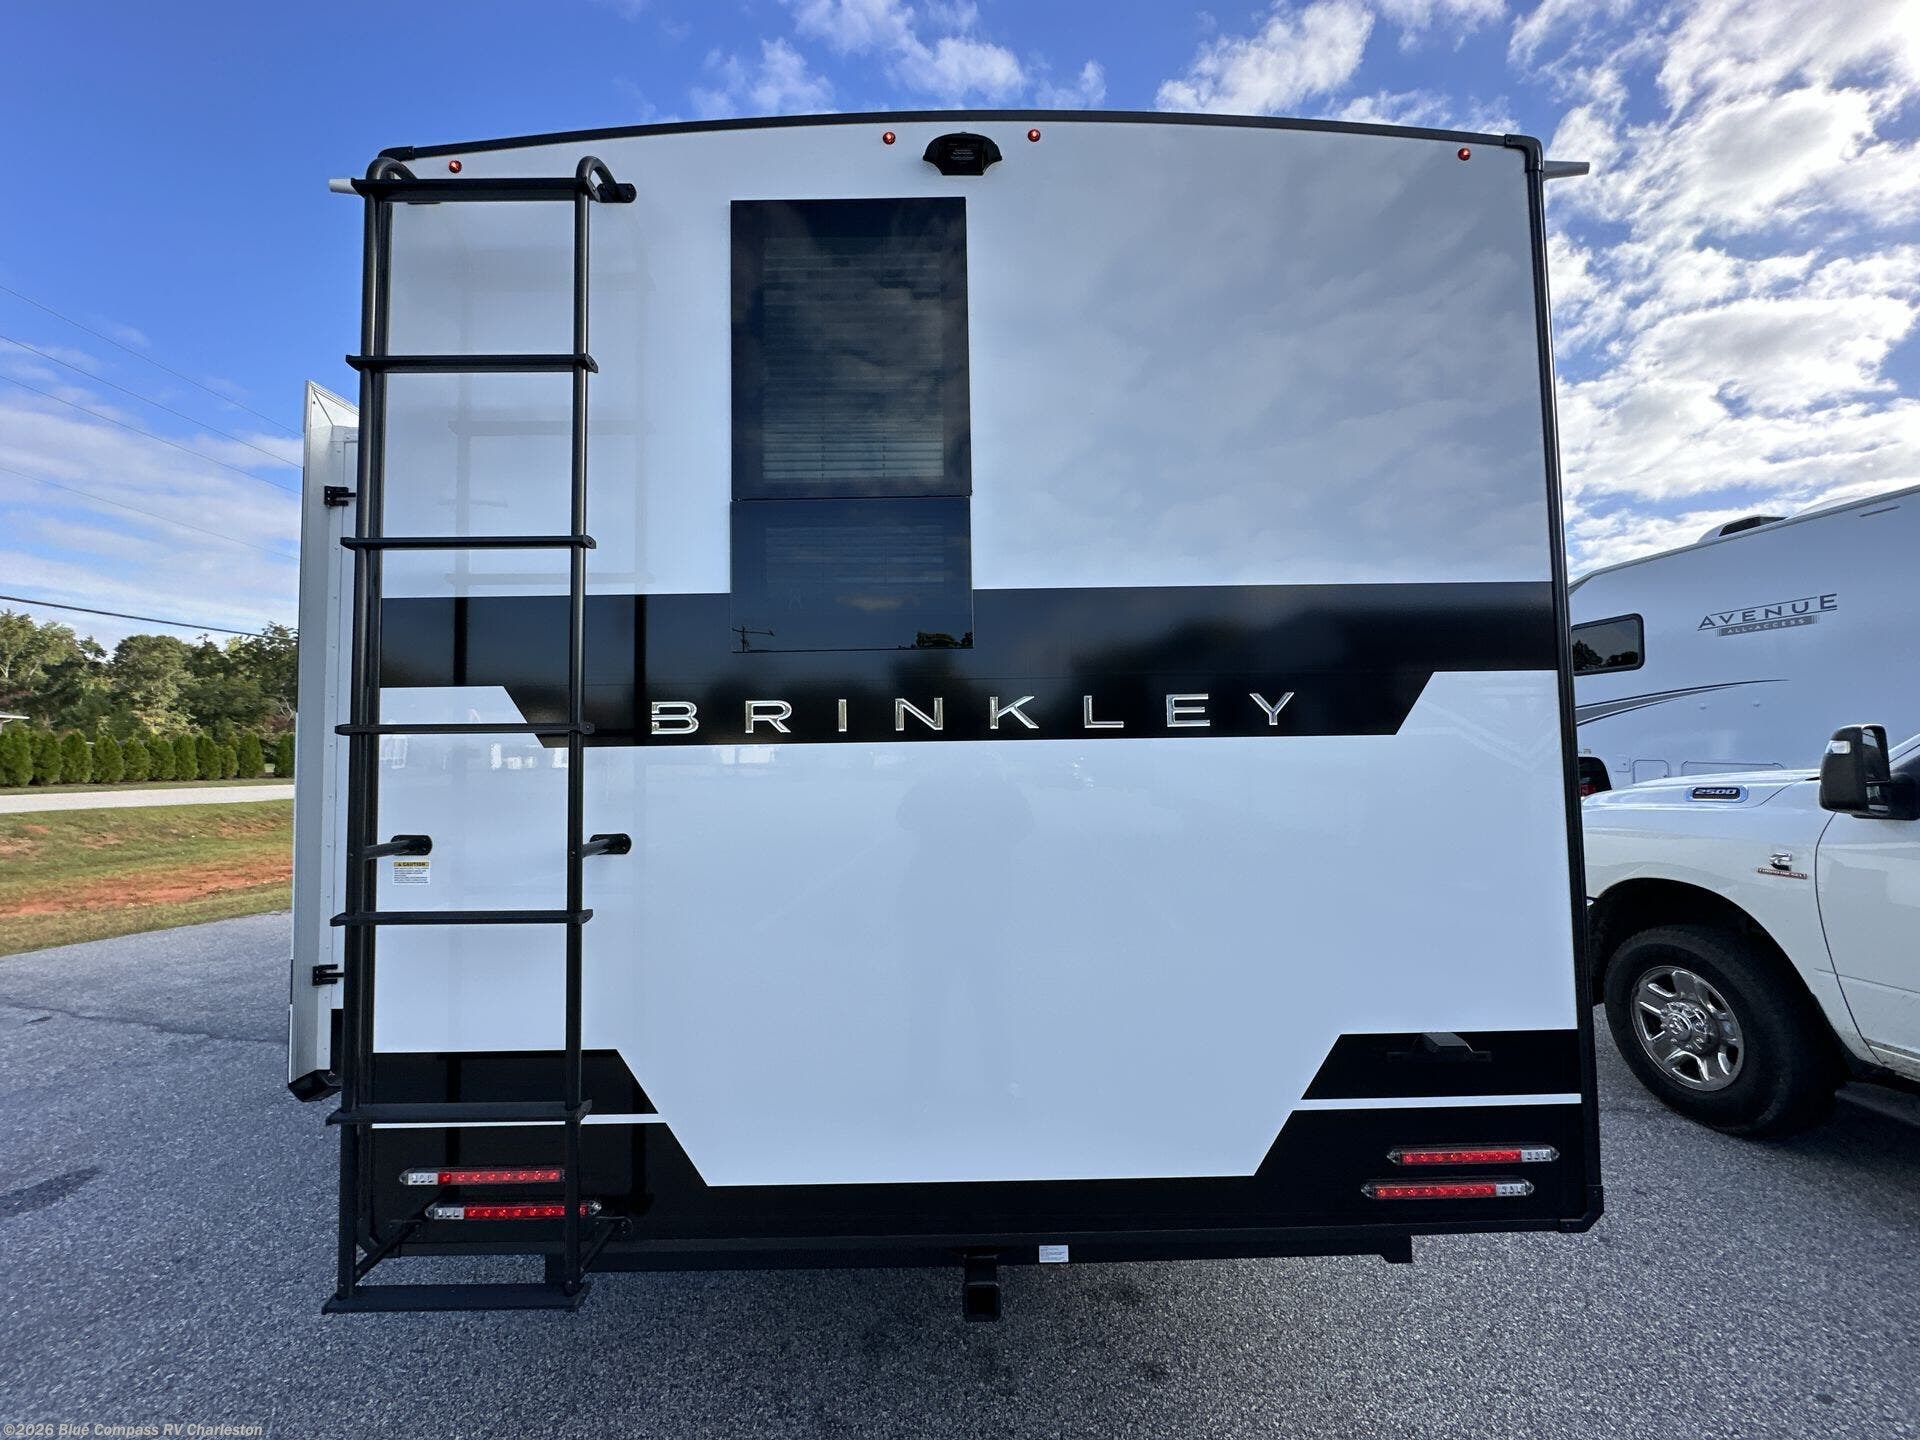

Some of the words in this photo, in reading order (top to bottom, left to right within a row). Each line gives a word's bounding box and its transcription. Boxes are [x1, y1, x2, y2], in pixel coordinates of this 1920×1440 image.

[1699, 593, 1837, 629] AVENUE
[1727, 618, 1805, 634] ALL-ACCESS
[651, 692, 1295, 735] BRINKLEY
